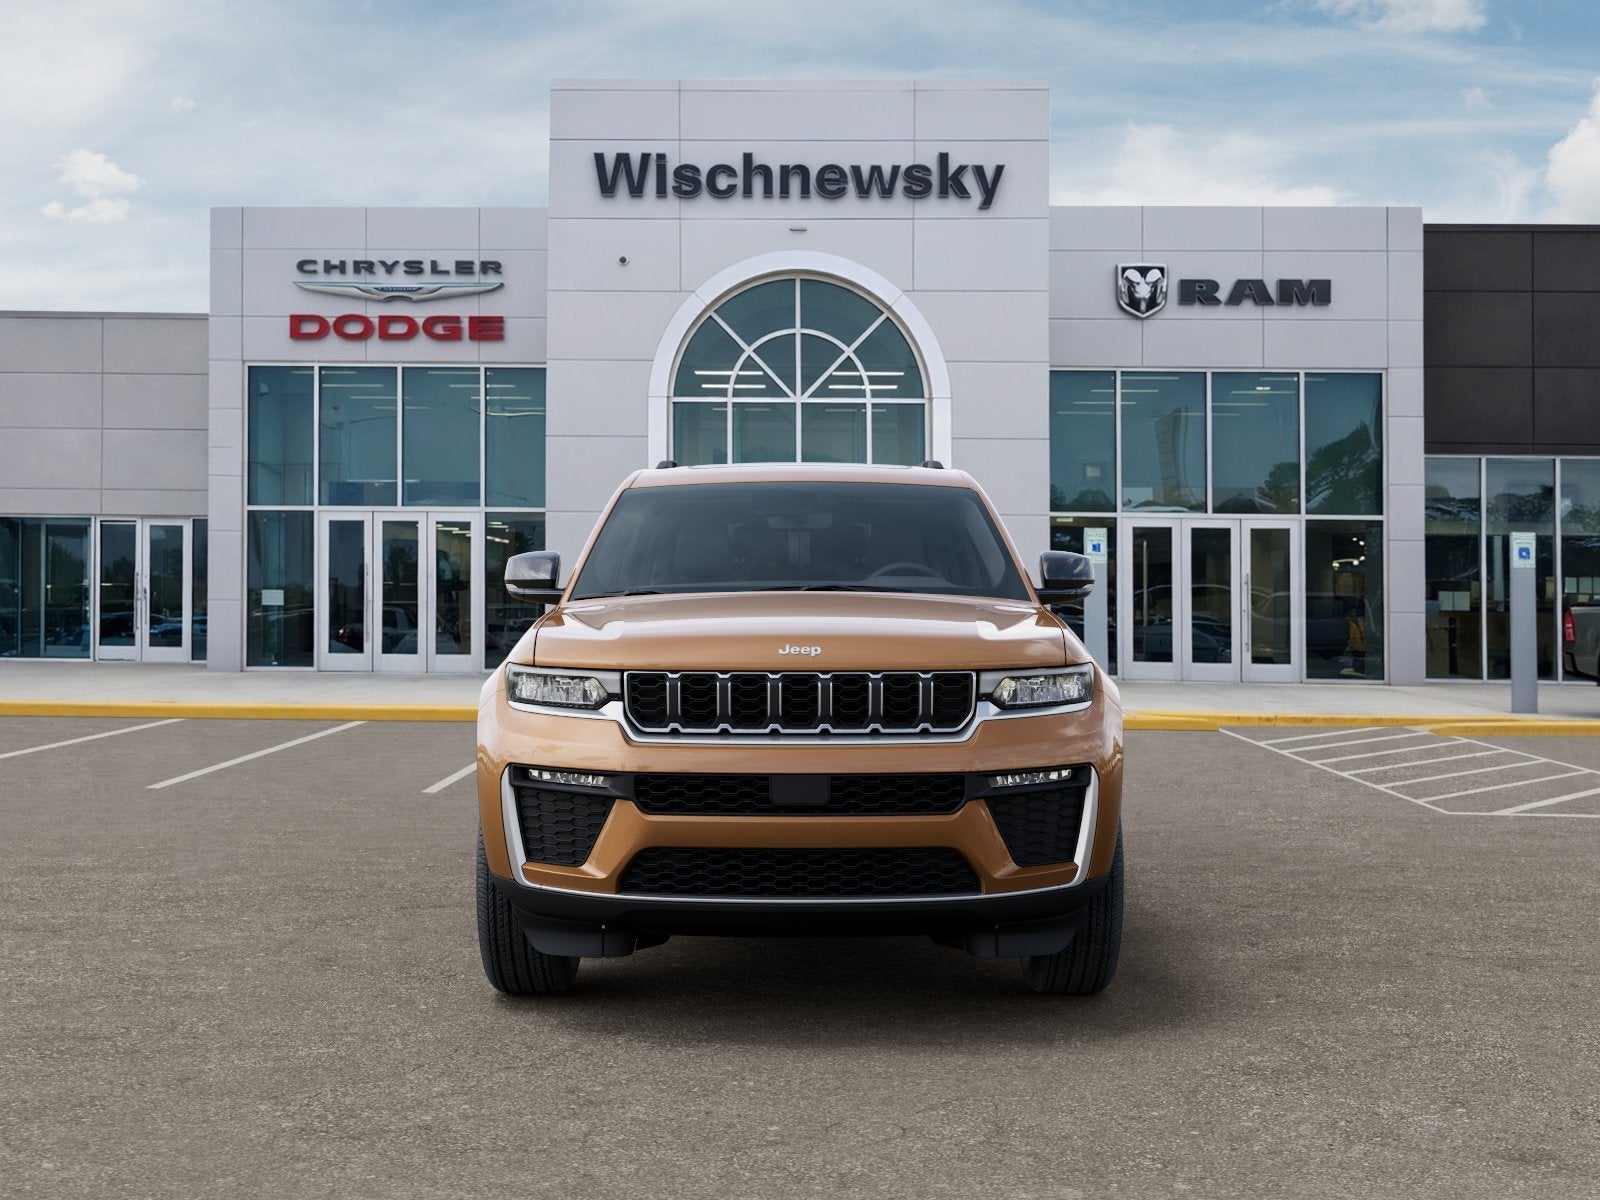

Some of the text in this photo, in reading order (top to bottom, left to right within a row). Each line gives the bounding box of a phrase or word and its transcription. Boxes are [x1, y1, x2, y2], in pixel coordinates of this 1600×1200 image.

[593, 152, 1005, 210] Wischnewsky
[296, 259, 503, 275] CHRYSLER
[1178, 279, 1332, 306] RAM
[289, 314, 504, 341] DODGE
[778, 643, 822, 657] Jeep
